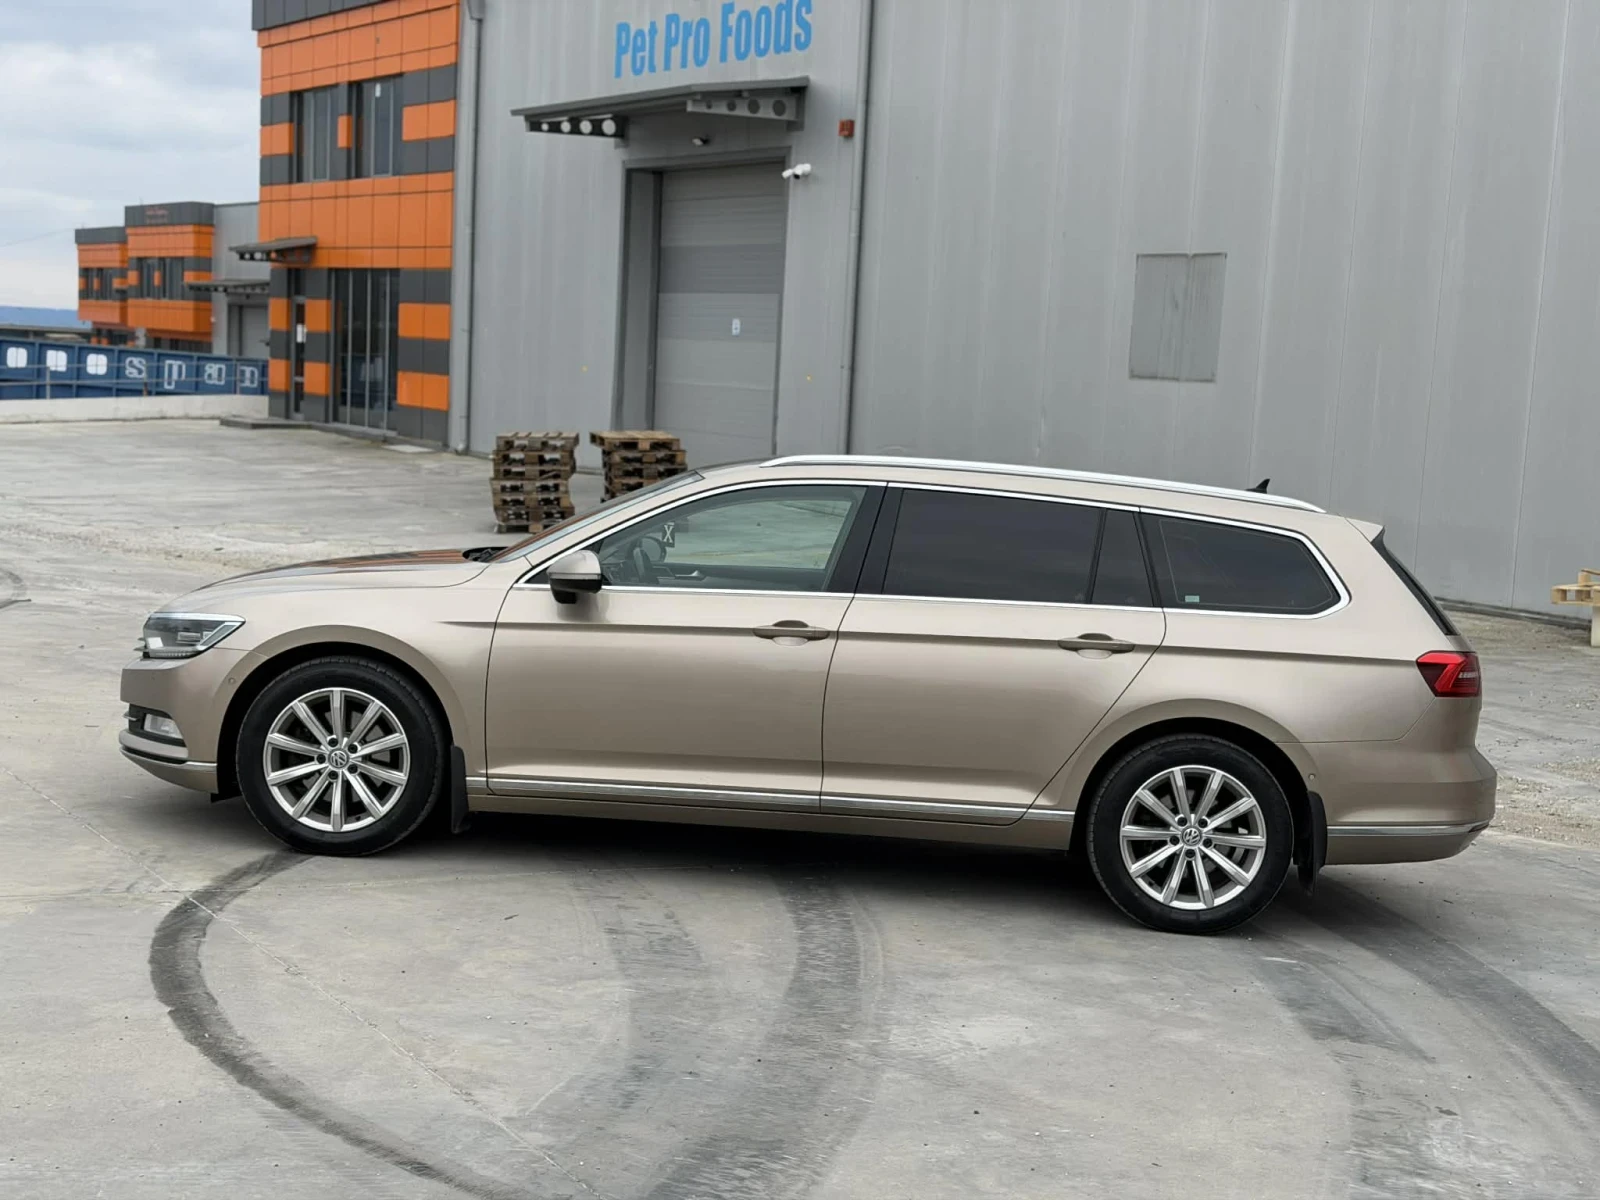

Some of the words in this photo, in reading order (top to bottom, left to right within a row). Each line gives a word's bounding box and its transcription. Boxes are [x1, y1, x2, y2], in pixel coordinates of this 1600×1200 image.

[613, 20, 658, 79] Pet
[662, 13, 711, 72] Pro
[719, 0, 813, 64] Foods
